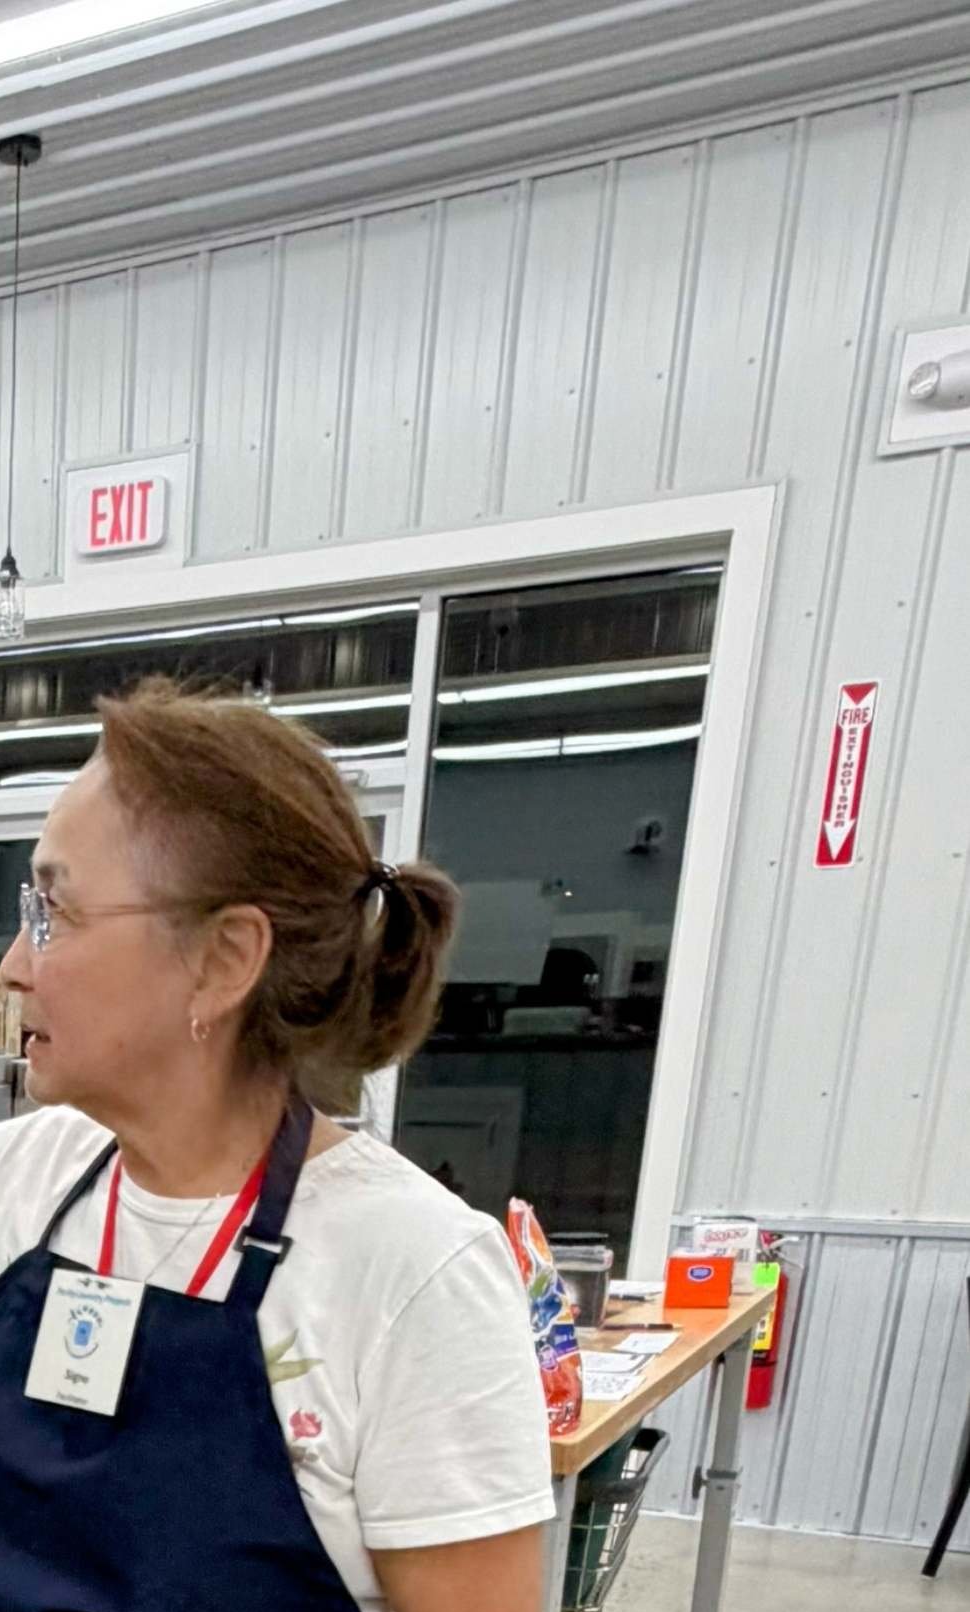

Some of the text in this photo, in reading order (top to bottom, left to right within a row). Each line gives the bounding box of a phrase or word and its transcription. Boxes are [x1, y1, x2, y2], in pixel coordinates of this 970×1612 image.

[91, 480, 153, 546] EXIT
[841, 707, 871, 726] FIRE
[834, 727, 858, 828] EXTINGUISHER
